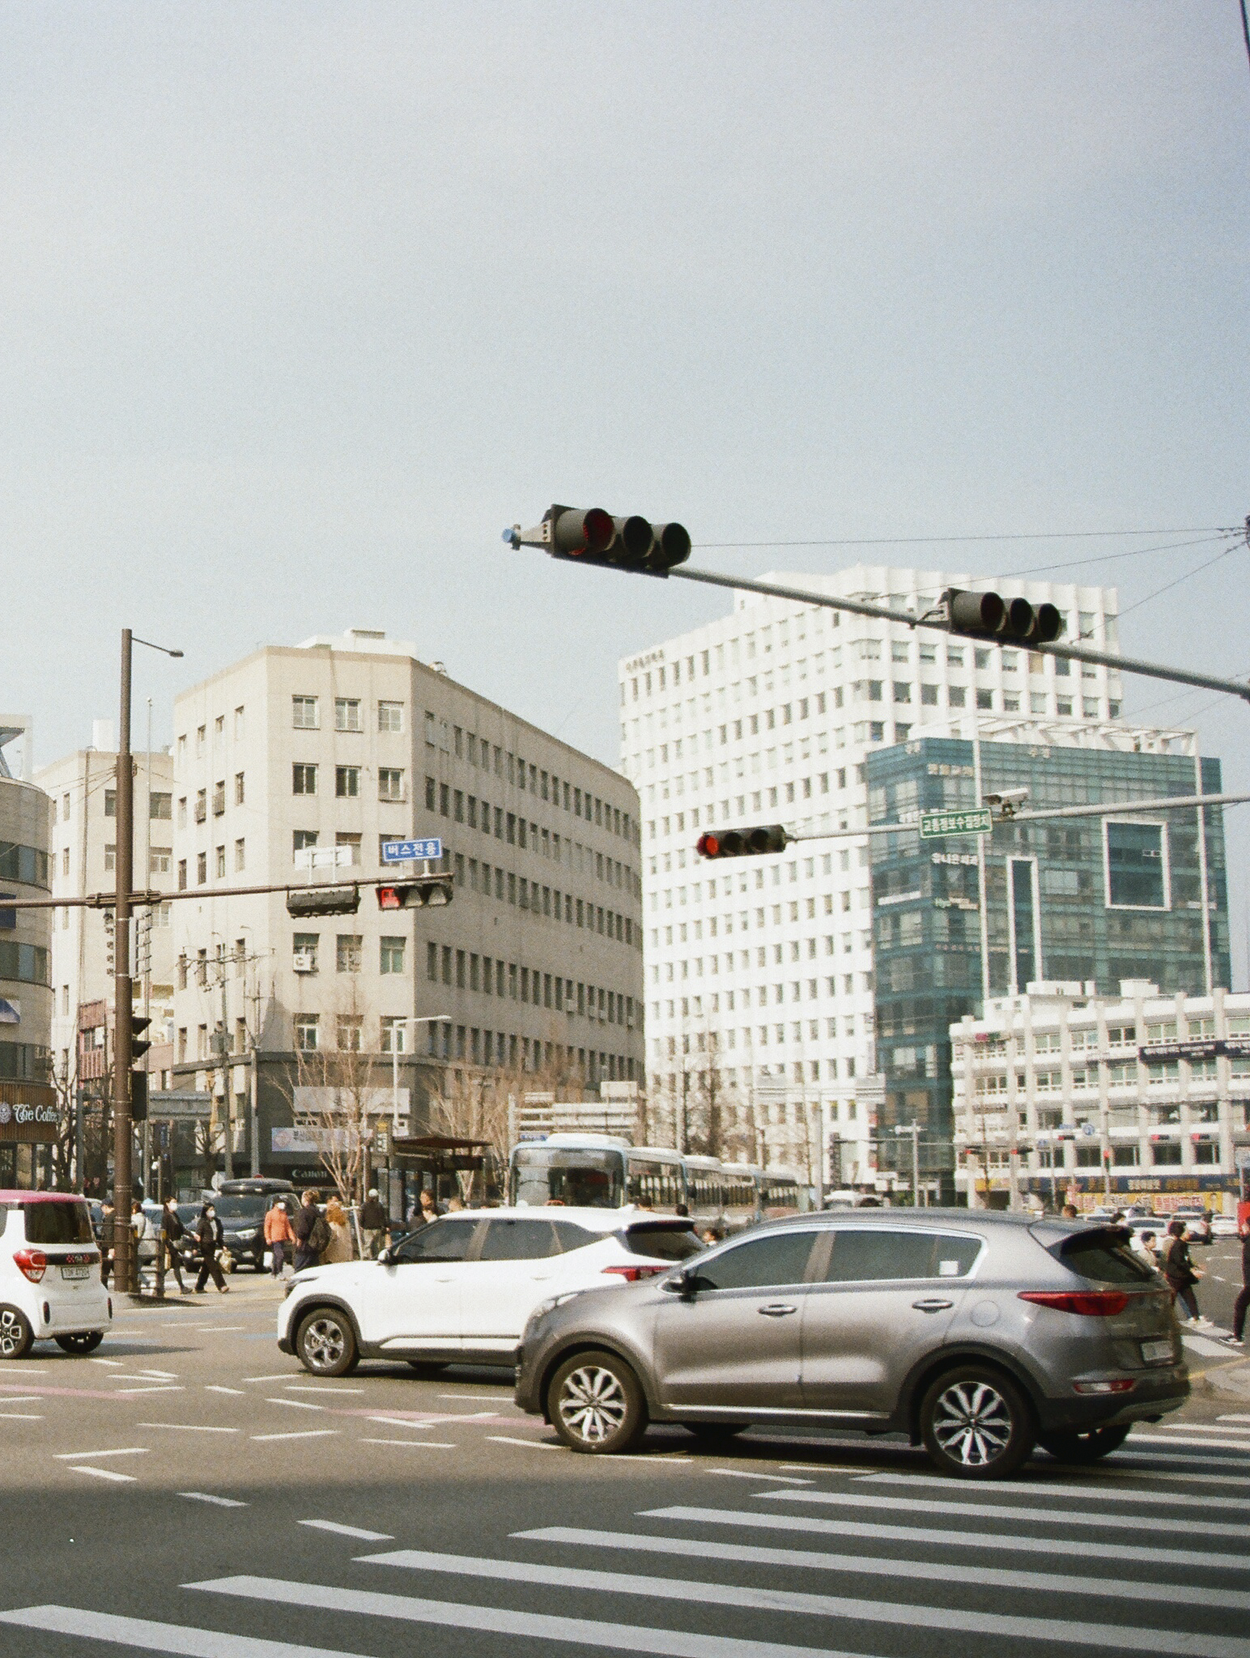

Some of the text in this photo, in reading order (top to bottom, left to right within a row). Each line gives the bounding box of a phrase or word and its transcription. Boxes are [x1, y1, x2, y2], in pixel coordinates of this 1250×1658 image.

[387, 842, 436, 856] 버스전용
[13, 1104, 34, 1123] The
[291, 1168, 328, 1179] Canon
